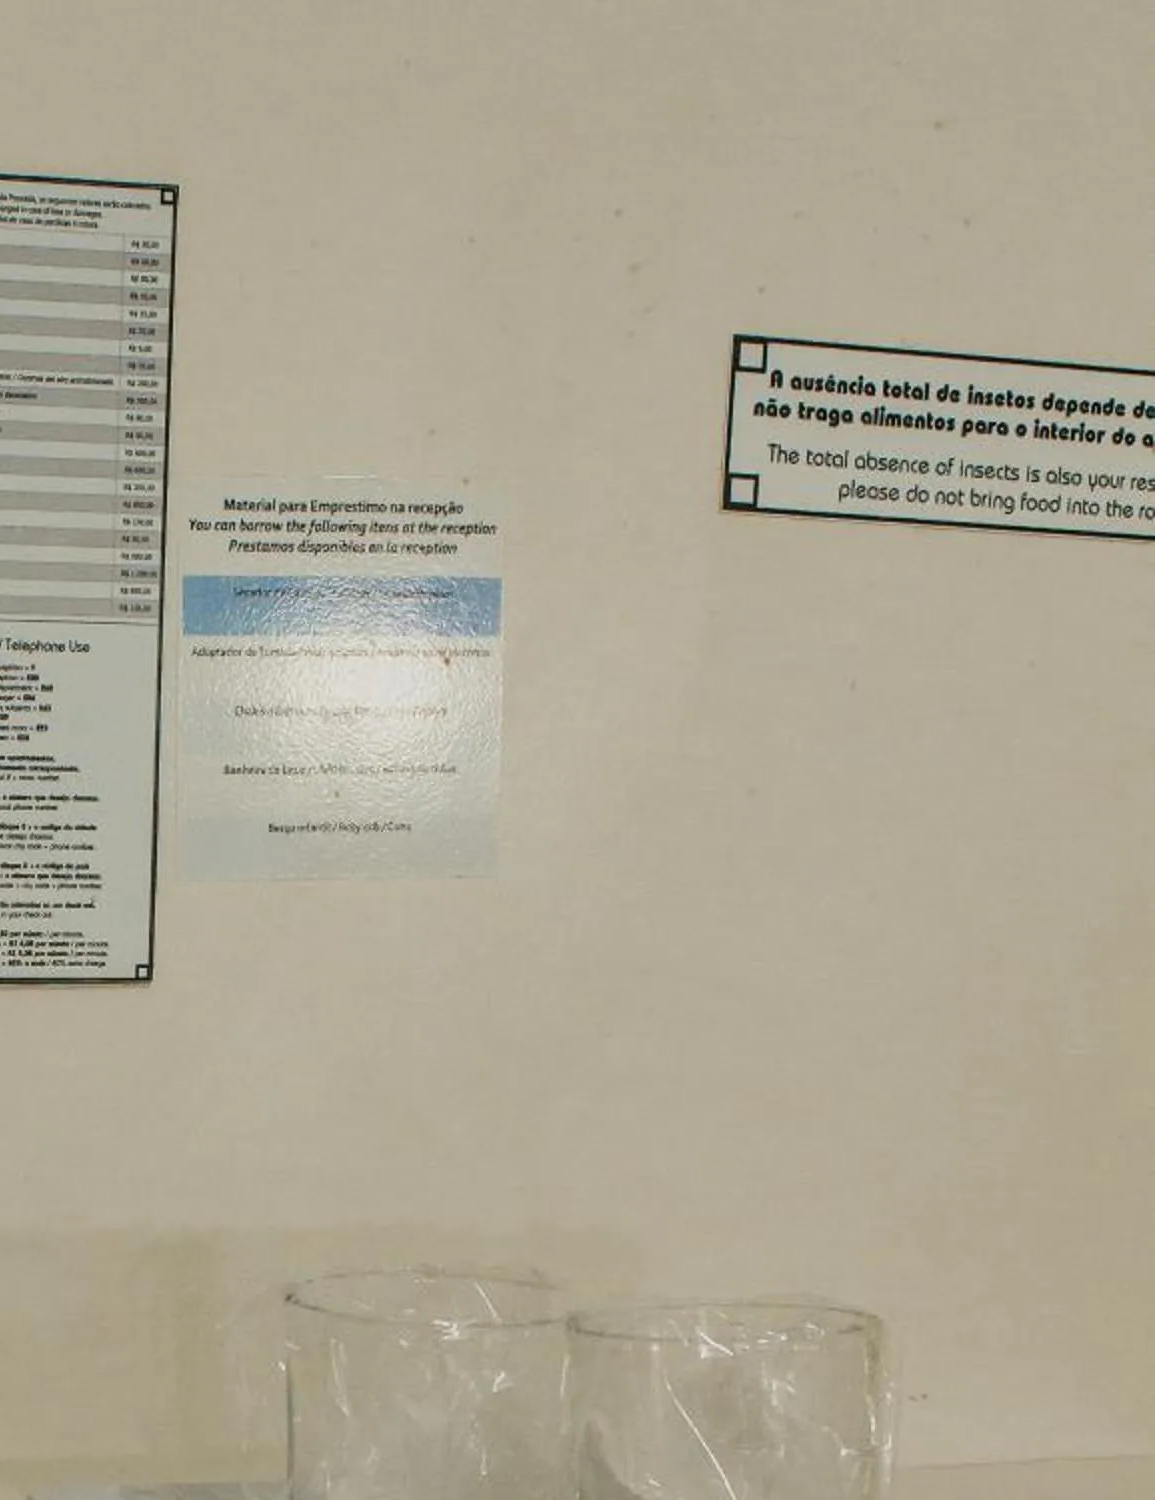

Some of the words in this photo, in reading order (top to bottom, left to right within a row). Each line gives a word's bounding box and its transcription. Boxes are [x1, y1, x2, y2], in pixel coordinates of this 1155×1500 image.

[769, 368, 783, 388] A
[790, 376, 877, 396] ausência
[882, 380, 930, 400] total
[935, 384, 961, 403] de
[967, 387, 1035, 409] insetos
[1041, 394, 1126, 416] depende
[1132, 400, 1155, 419] de
[753, 399, 792, 418] não
[797, 403, 854, 427] traga
[860, 408, 955, 431] alimentos
[960, 419, 1009, 436] para
[1014, 423, 1027, 437] o
[1033, 421, 1106, 443] interior
[1111, 427, 1136, 446] do
[1141, 433, 1155, 448] a
[767, 443, 800, 464] The
[805, 449, 850, 468] total
[854, 453, 930, 474] absence
[934, 457, 955, 476] of
[959, 462, 1020, 481] insects
[1025, 465, 1041, 483] is
[1045, 467, 1083, 486] also
[1087, 473, 1126, 491] your
[1129, 477, 1155, 492] res
[223, 498, 276, 512] Material
[278, 502, 308, 514] para
[309, 500, 388, 514] Emprestimo
[389, 503, 405, 513] na
[407, 502, 464, 516] recepção
[838, 481, 900, 501] please
[905, 484, 930, 503] do
[934, 490, 965, 506] not
[969, 489, 1016, 514] bring
[1019, 492, 1062, 513] food
[1066, 498, 1101, 516] into
[1105, 499, 1134, 518] the
[1137, 505, 1155, 521] ro
[188, 518, 212, 531] You
[213, 521, 237, 532] can
[238, 519, 283, 532] borrow
[285, 519, 308, 533] the
[307, 519, 368, 536] following
[401, 522, 416, 534] at
[417, 521, 439, 534] the
[439, 523, 498, 536] reception
[227, 539, 295, 553] Prestamos
[399, 542, 458, 555] reception
[5, 638, 66, 653] Telephone
[68, 640, 90, 653] Use
